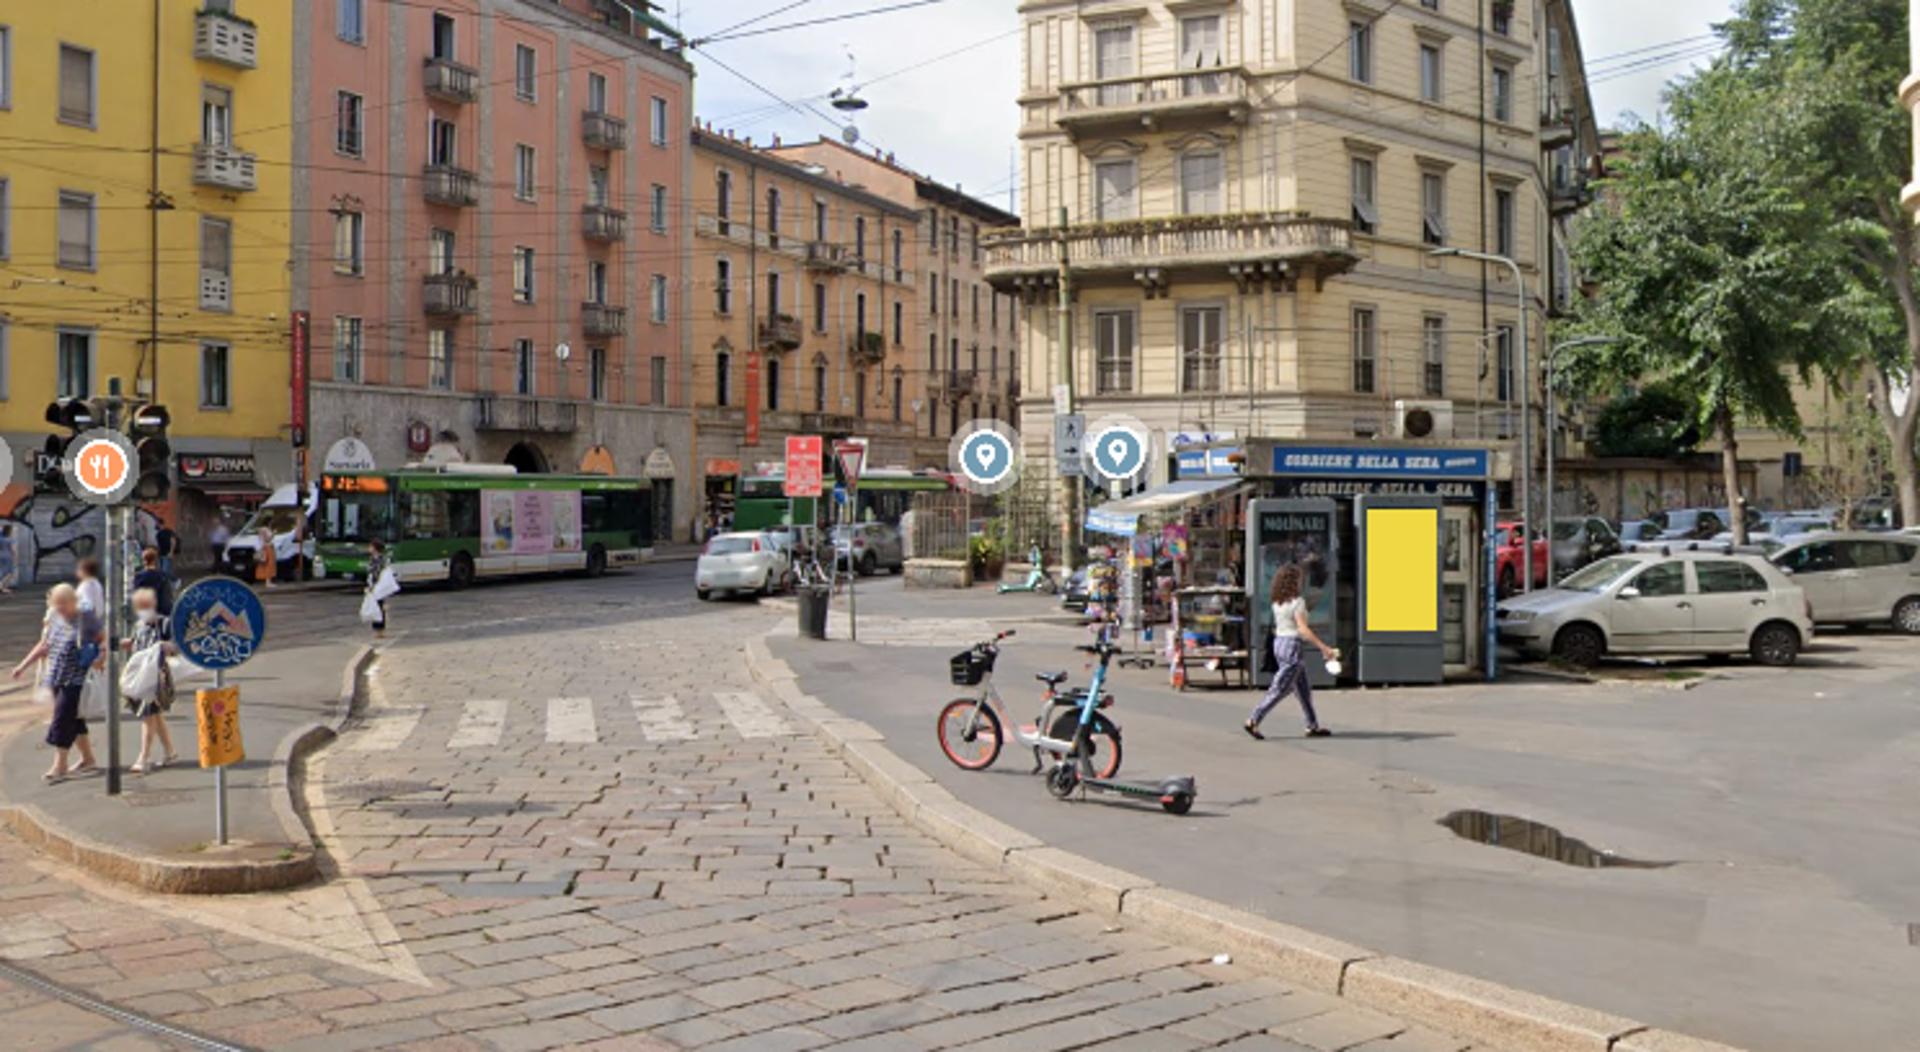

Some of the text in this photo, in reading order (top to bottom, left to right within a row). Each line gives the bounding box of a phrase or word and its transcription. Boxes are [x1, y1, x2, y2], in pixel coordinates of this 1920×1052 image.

[1284, 455, 1352, 468] CORRIERE
[1356, 455, 1399, 469] DELLA
[1405, 456, 1440, 469] SERA
[1436, 483, 1474, 497] SERA
[1263, 516, 1326, 531] MOLINARI
